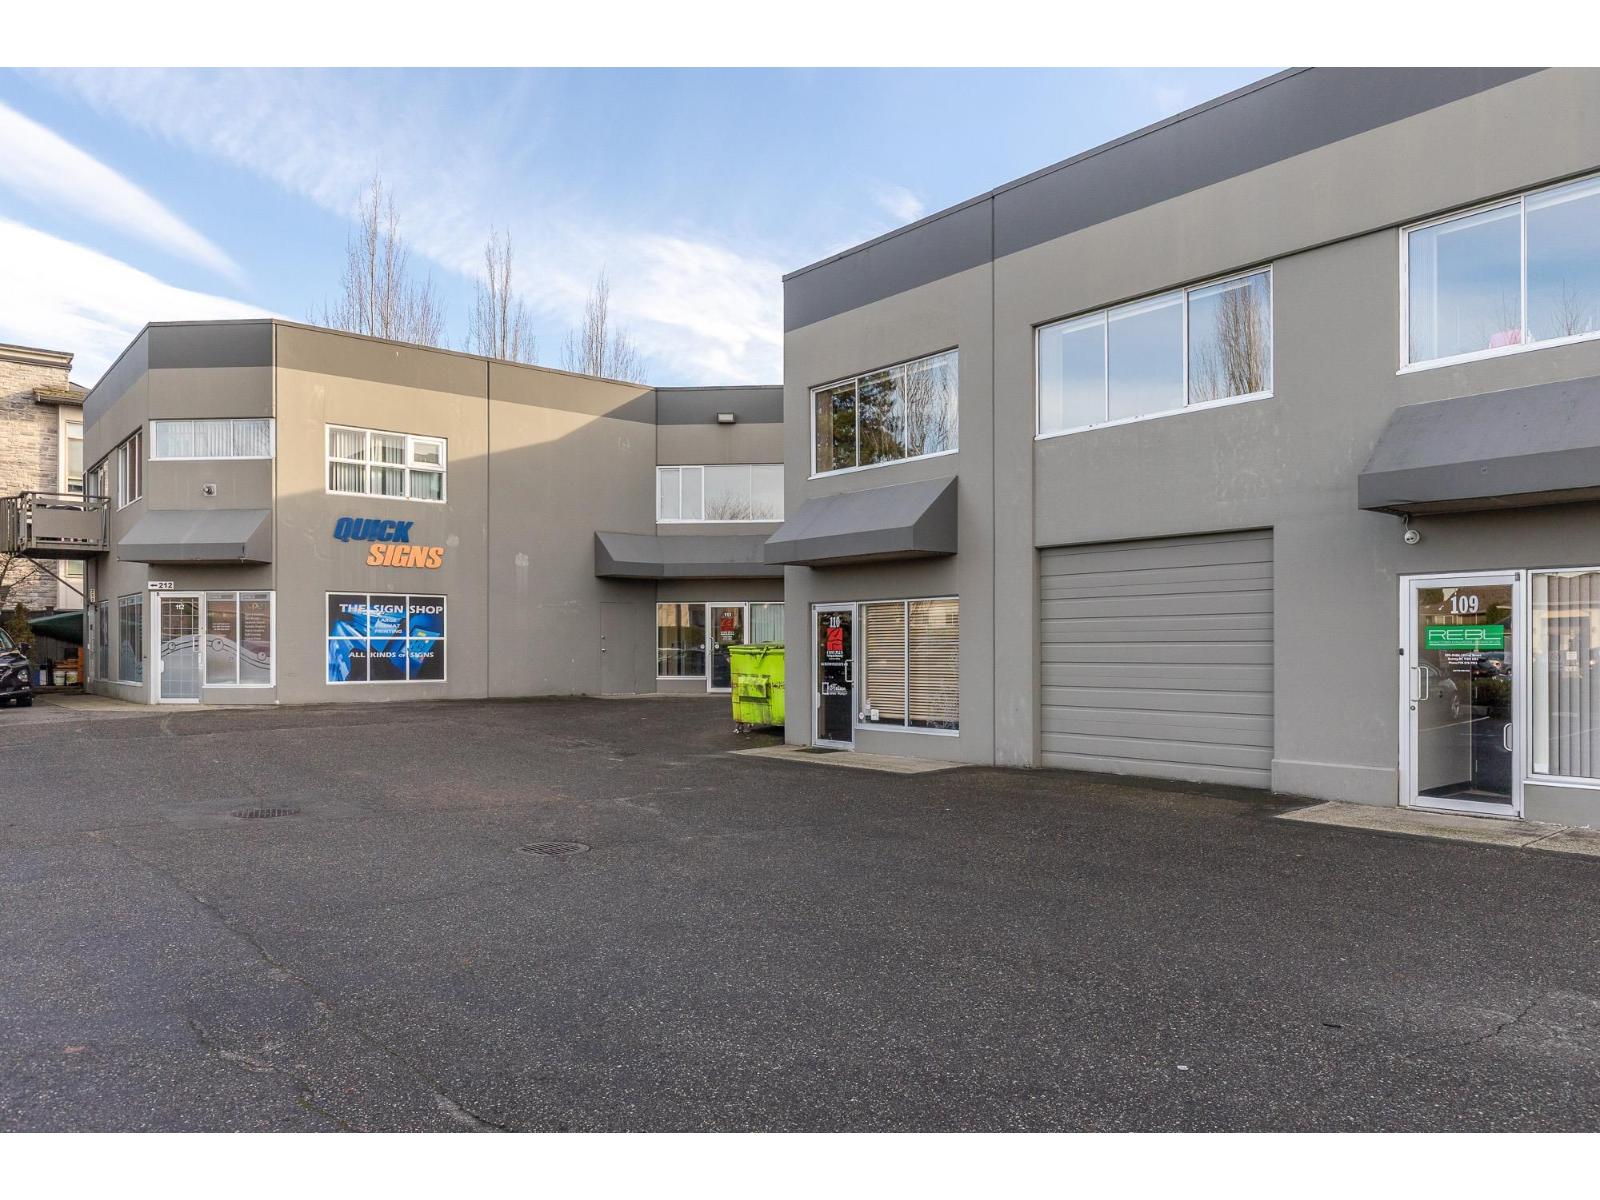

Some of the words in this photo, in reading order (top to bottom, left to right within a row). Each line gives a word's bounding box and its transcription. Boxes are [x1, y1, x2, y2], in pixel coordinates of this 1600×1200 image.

[333, 517, 414, 542] QUICK
[366, 543, 444, 569] SIGNS
[339, 604, 367, 613] THE
[373, 604, 404, 614] SIGN
[409, 605, 443, 614] SHOP
[1450, 595, 1479, 614] 109
[1428, 629, 1502, 641] REBL
